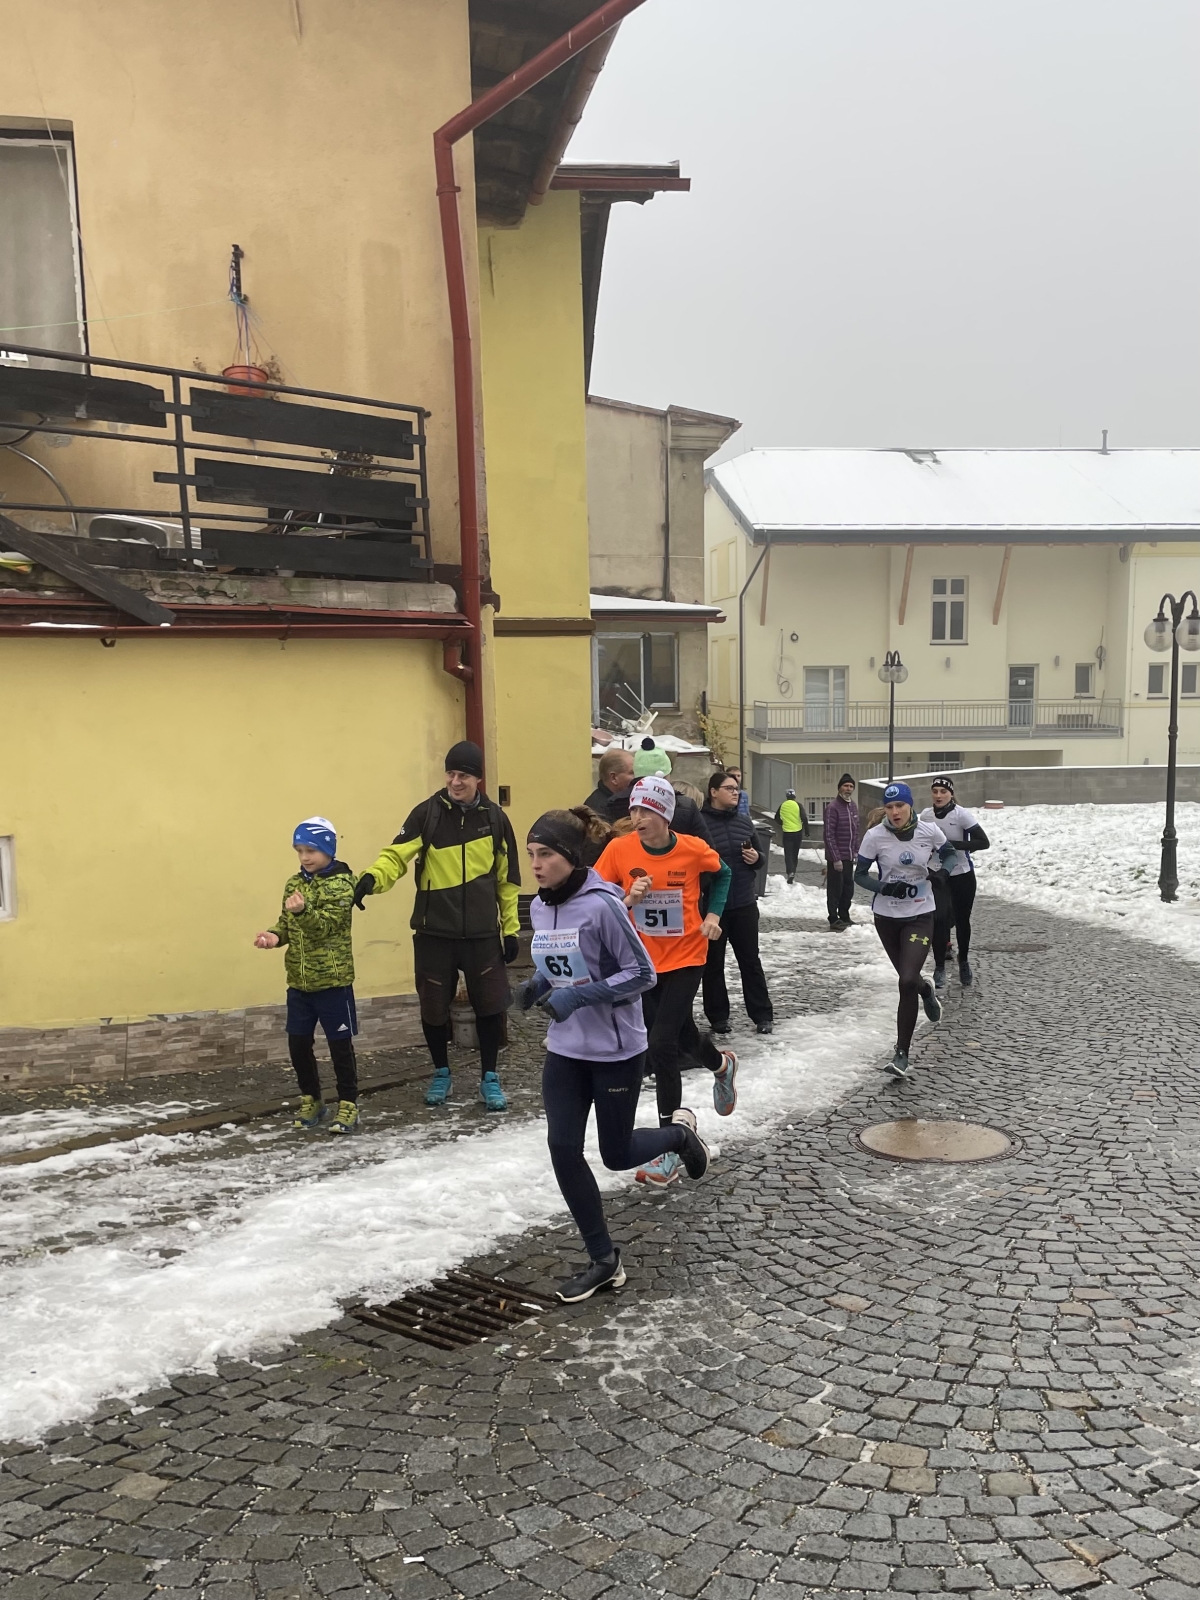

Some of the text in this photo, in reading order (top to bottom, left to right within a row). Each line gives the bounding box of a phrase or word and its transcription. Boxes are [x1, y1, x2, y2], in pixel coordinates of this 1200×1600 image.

[644, 909, 668, 928] 51
[560, 941, 577, 949] LIGA
[544, 955, 573, 977] 63
